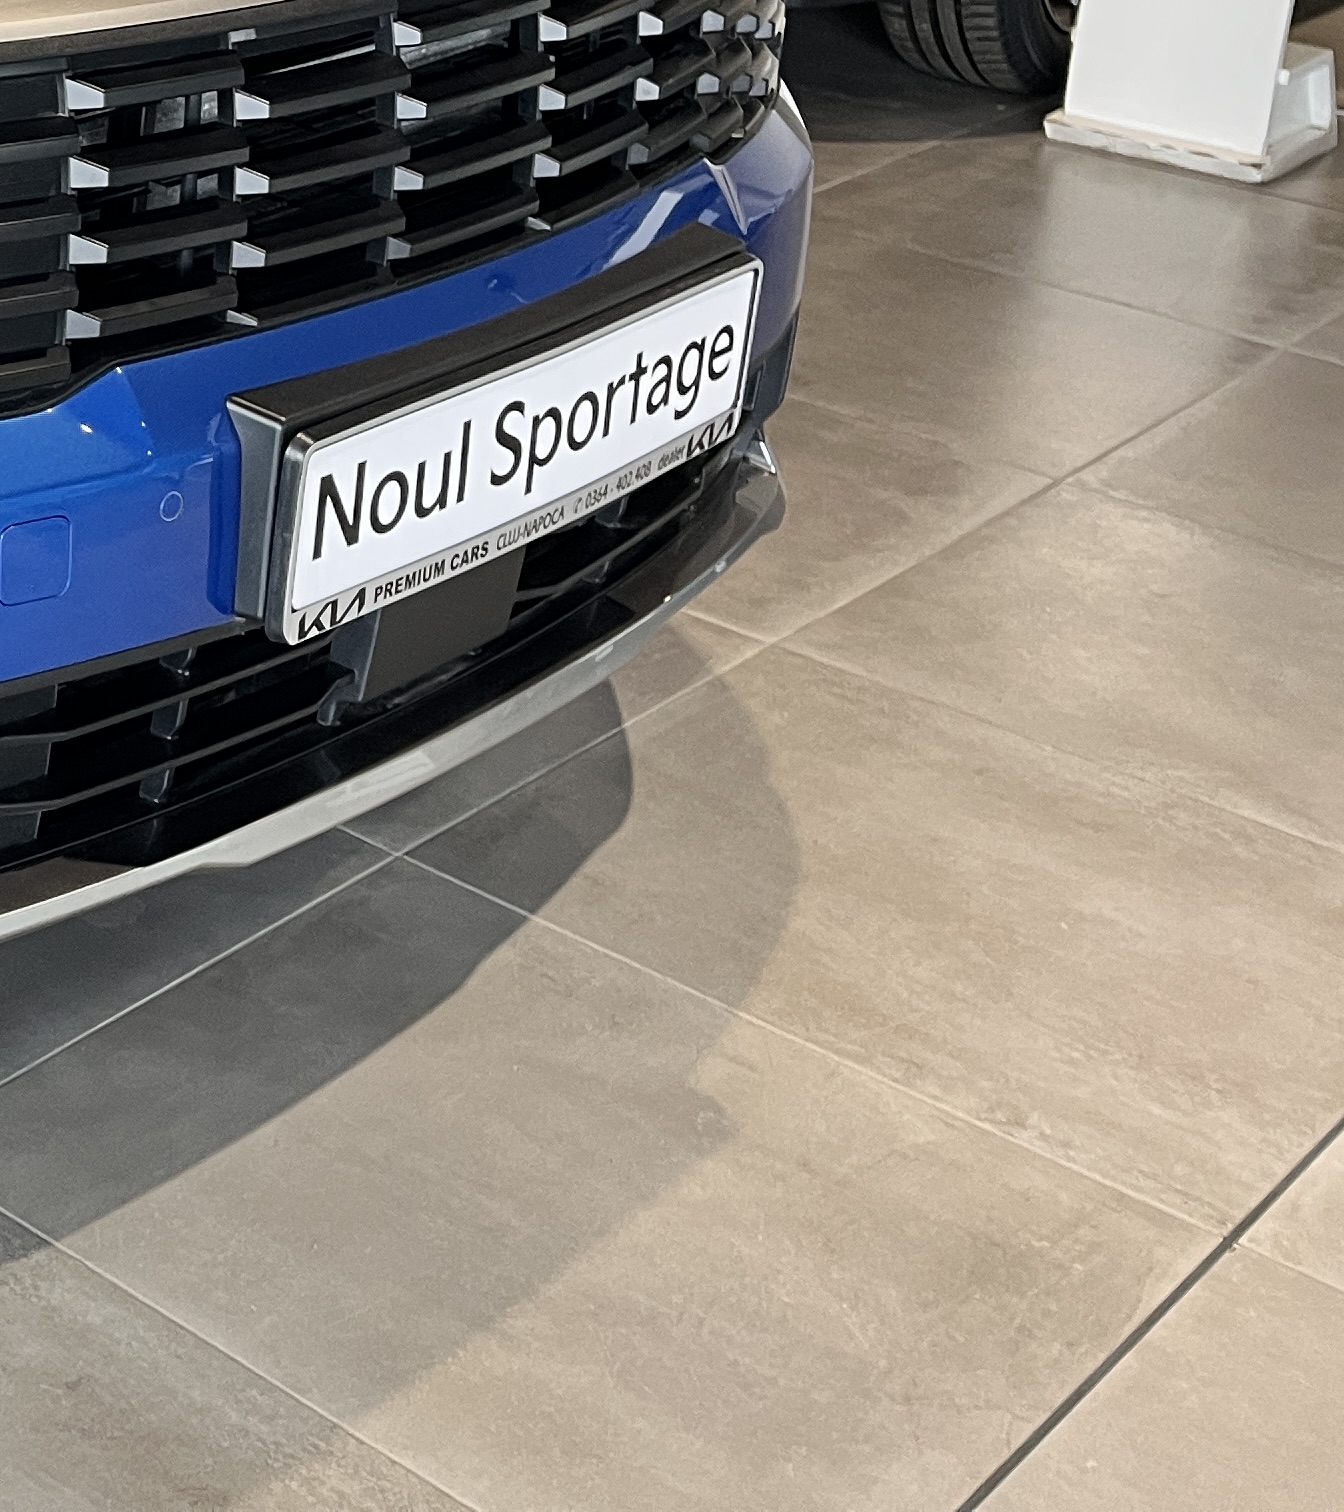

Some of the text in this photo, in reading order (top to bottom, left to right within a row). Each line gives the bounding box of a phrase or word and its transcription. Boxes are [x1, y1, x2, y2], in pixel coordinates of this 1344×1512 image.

[297, 586, 367, 641] KIA
[373, 558, 446, 604] PREMIUM
[450, 541, 489, 572] CARS
[496, 504, 565, 551] CLUJ-NAPOCA
[686, 411, 735, 460] KIA
[312, 324, 734, 561] Noul Sportage
